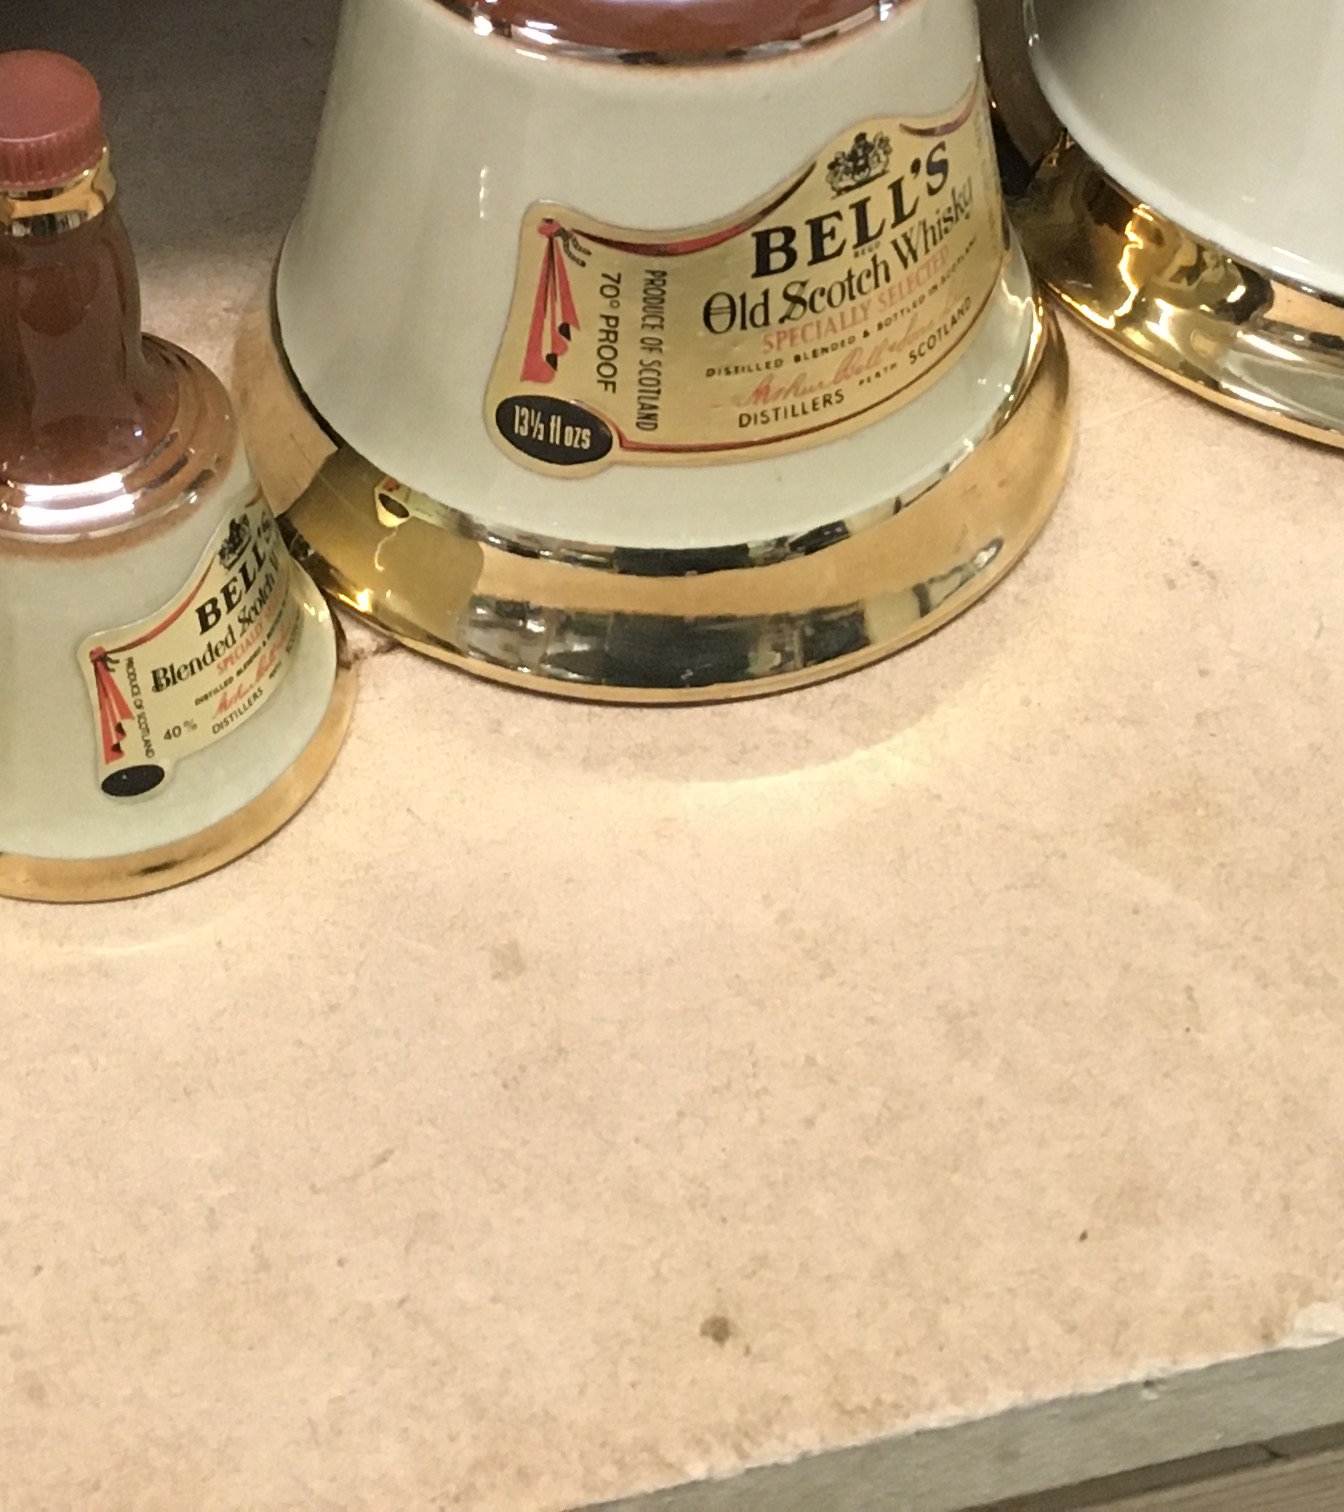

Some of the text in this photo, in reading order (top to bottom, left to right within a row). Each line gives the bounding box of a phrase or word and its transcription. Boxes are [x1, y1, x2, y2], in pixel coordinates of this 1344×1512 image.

[702, 287, 770, 335] Old
[778, 252, 892, 325] Scotch
[891, 176, 974, 271] Whisky
[750, 140, 950, 280] BELL'S
[706, 357, 785, 378] DISTILLED
[793, 335, 856, 364] BLENDED
[877, 293, 927, 333] BOTTLED
[762, 302, 871, 355] SPECIALLY
[877, 244, 950, 312] SELECTED
[596, 314, 620, 394] PROOF
[635, 268, 668, 432] PRODUCE OF SCOTLAND
[738, 388, 846, 429] DISTILLERS
[858, 363, 898, 387] PERTH
[908, 295, 972, 365] SCOTLAND
[564, 427, 592, 451] ozs
[150, 622, 238, 694] Blended
[211, 687, 265, 736] DISTILLERS
